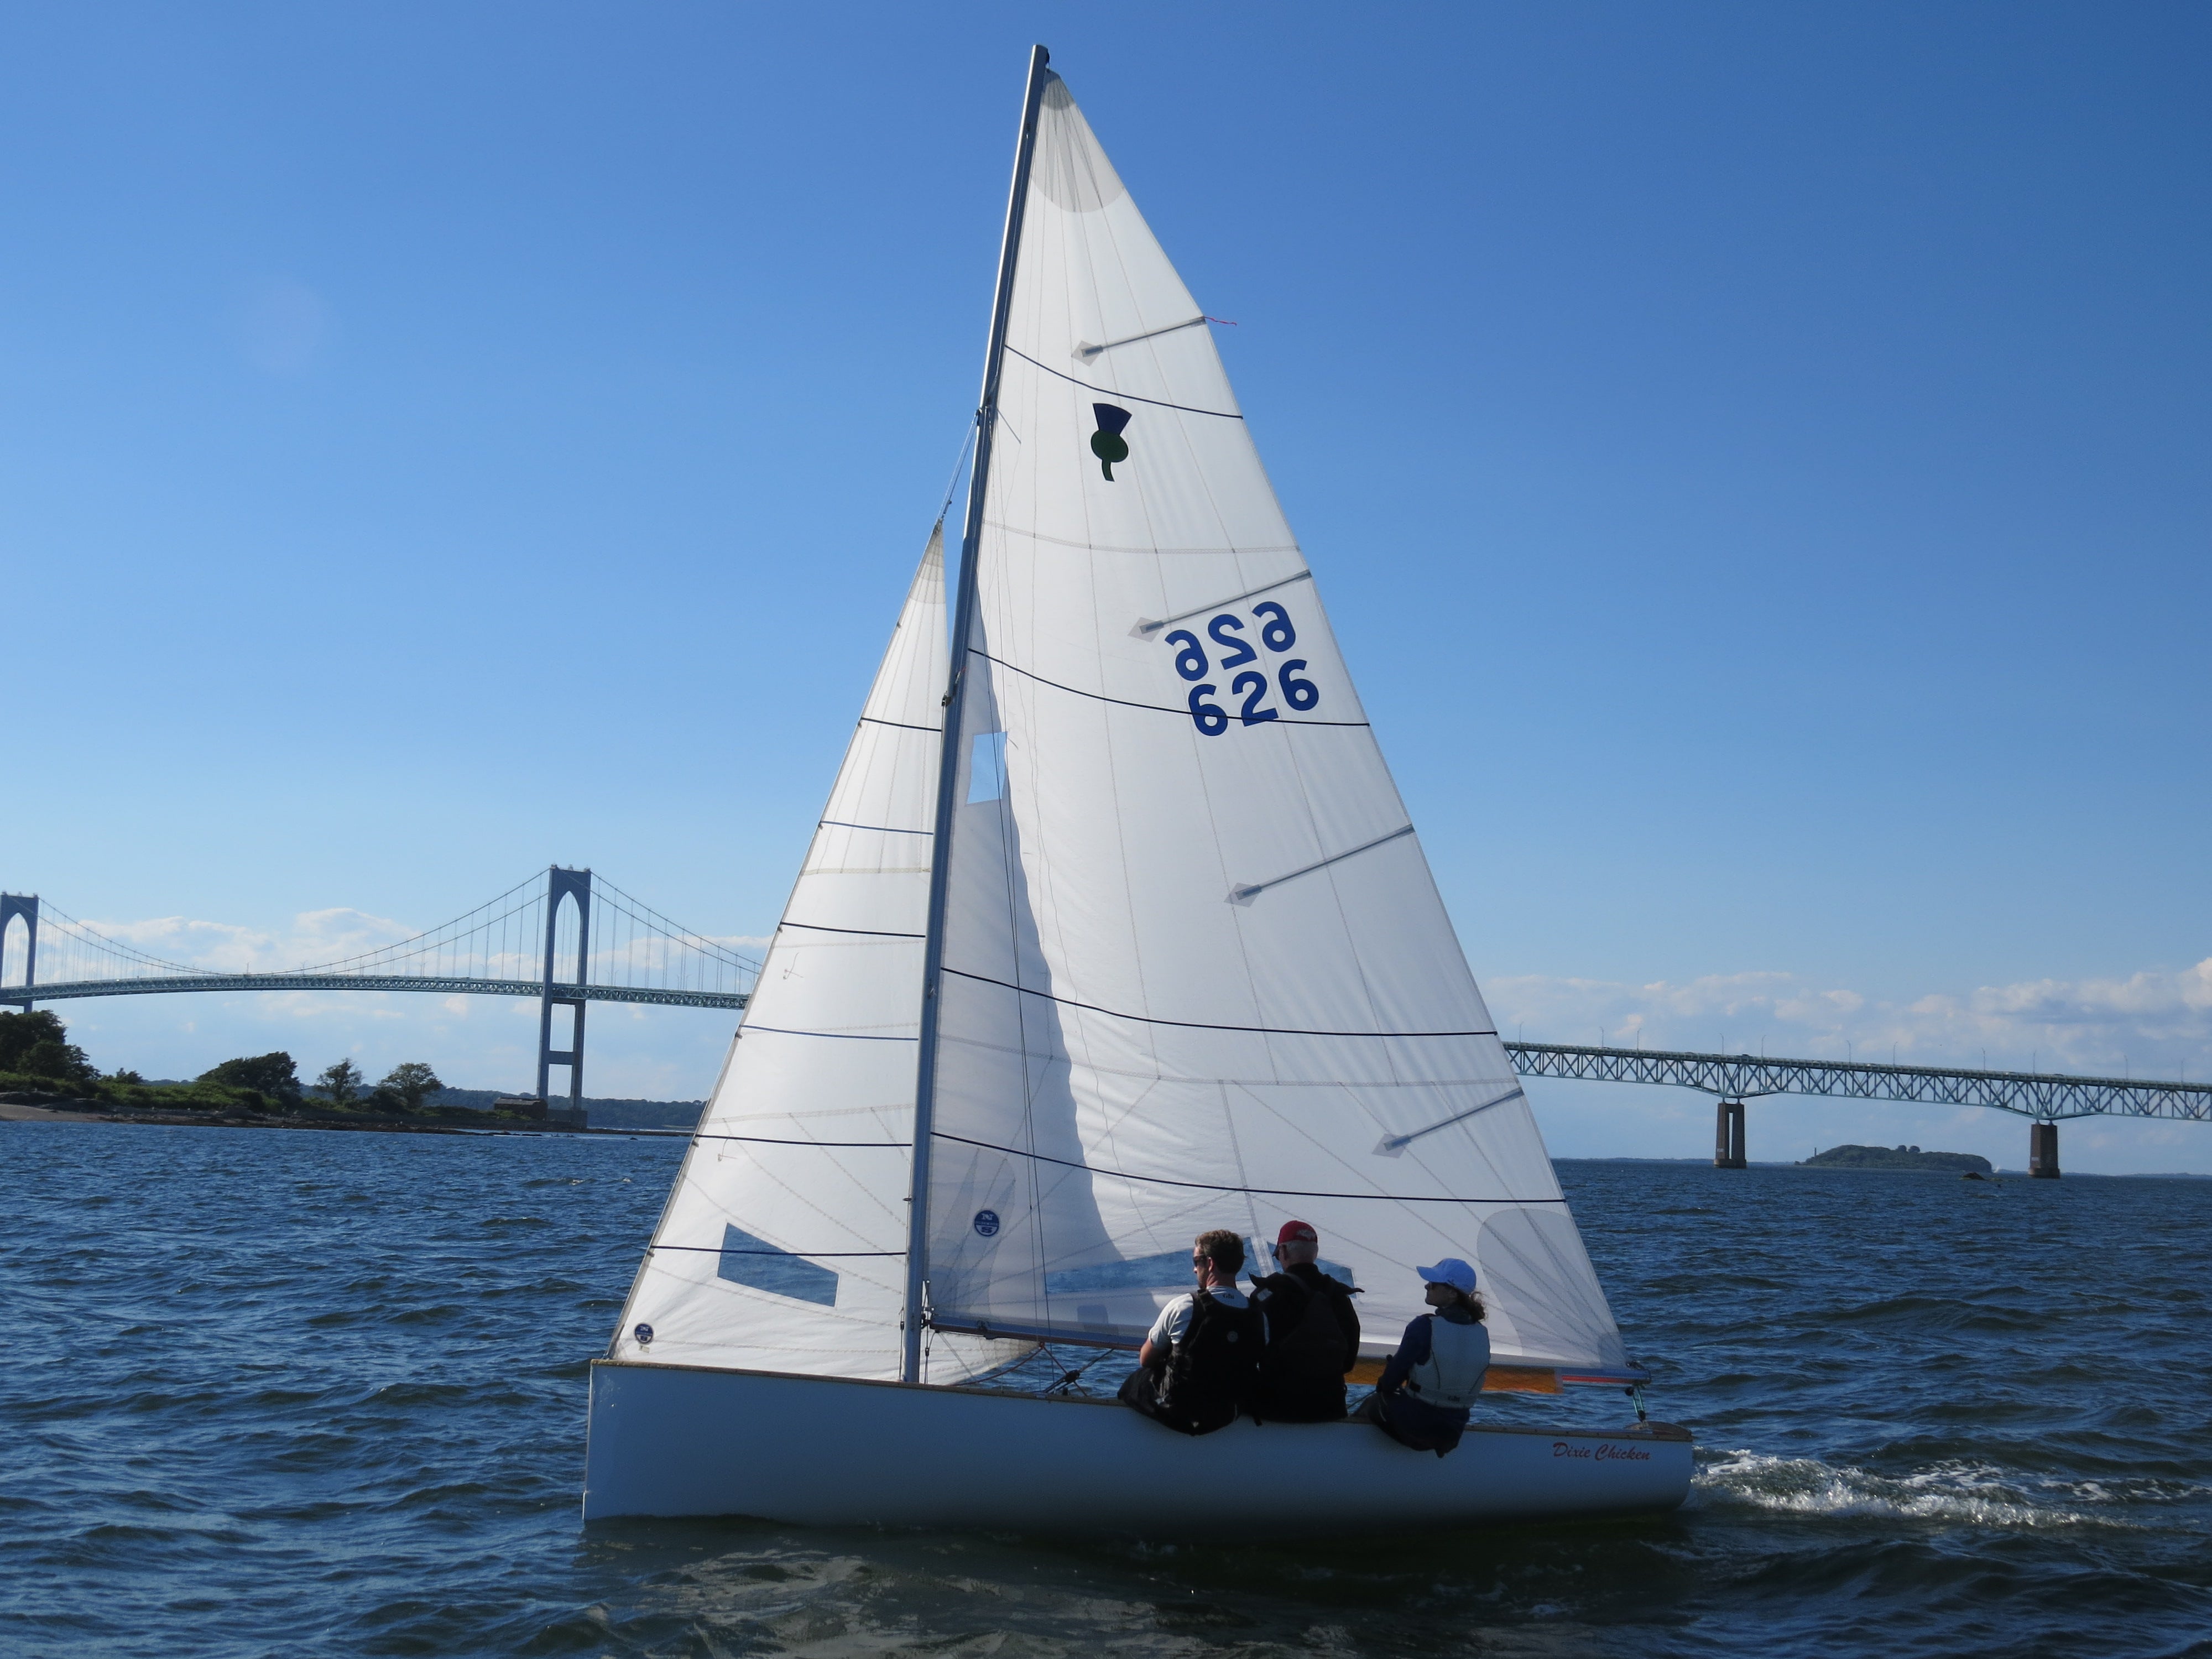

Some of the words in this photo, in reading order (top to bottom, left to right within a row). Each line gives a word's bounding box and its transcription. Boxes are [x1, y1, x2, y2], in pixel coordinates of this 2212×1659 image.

[1188, 659, 1319, 737] 626
[1553, 1442, 1591, 1458] Dixie
[1595, 1444, 1652, 1461] Chicken
